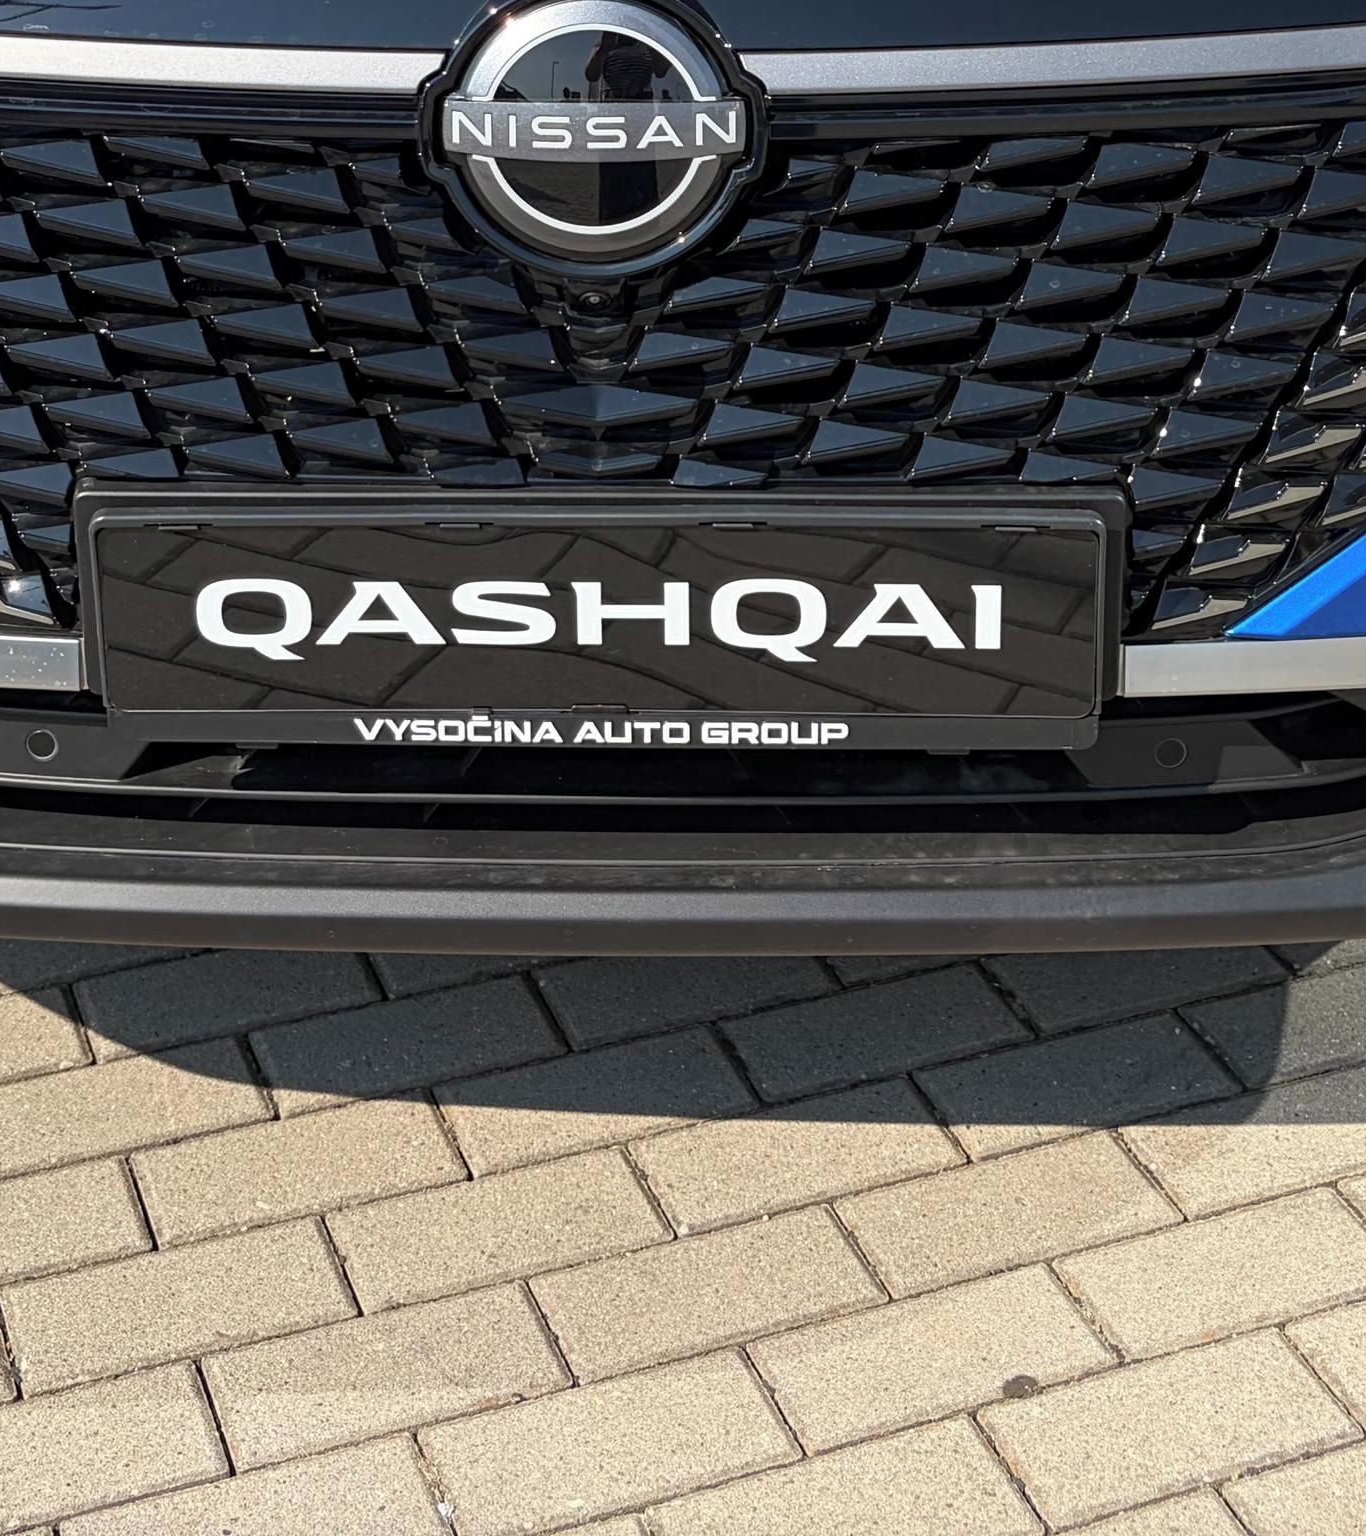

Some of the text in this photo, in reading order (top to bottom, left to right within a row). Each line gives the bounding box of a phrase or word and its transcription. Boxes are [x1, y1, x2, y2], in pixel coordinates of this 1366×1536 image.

[450, 109, 737, 149] NISSAN
[194, 577, 1005, 663] QASHQAI
[353, 714, 850, 745] VYSOČINA AUTO GROUP
